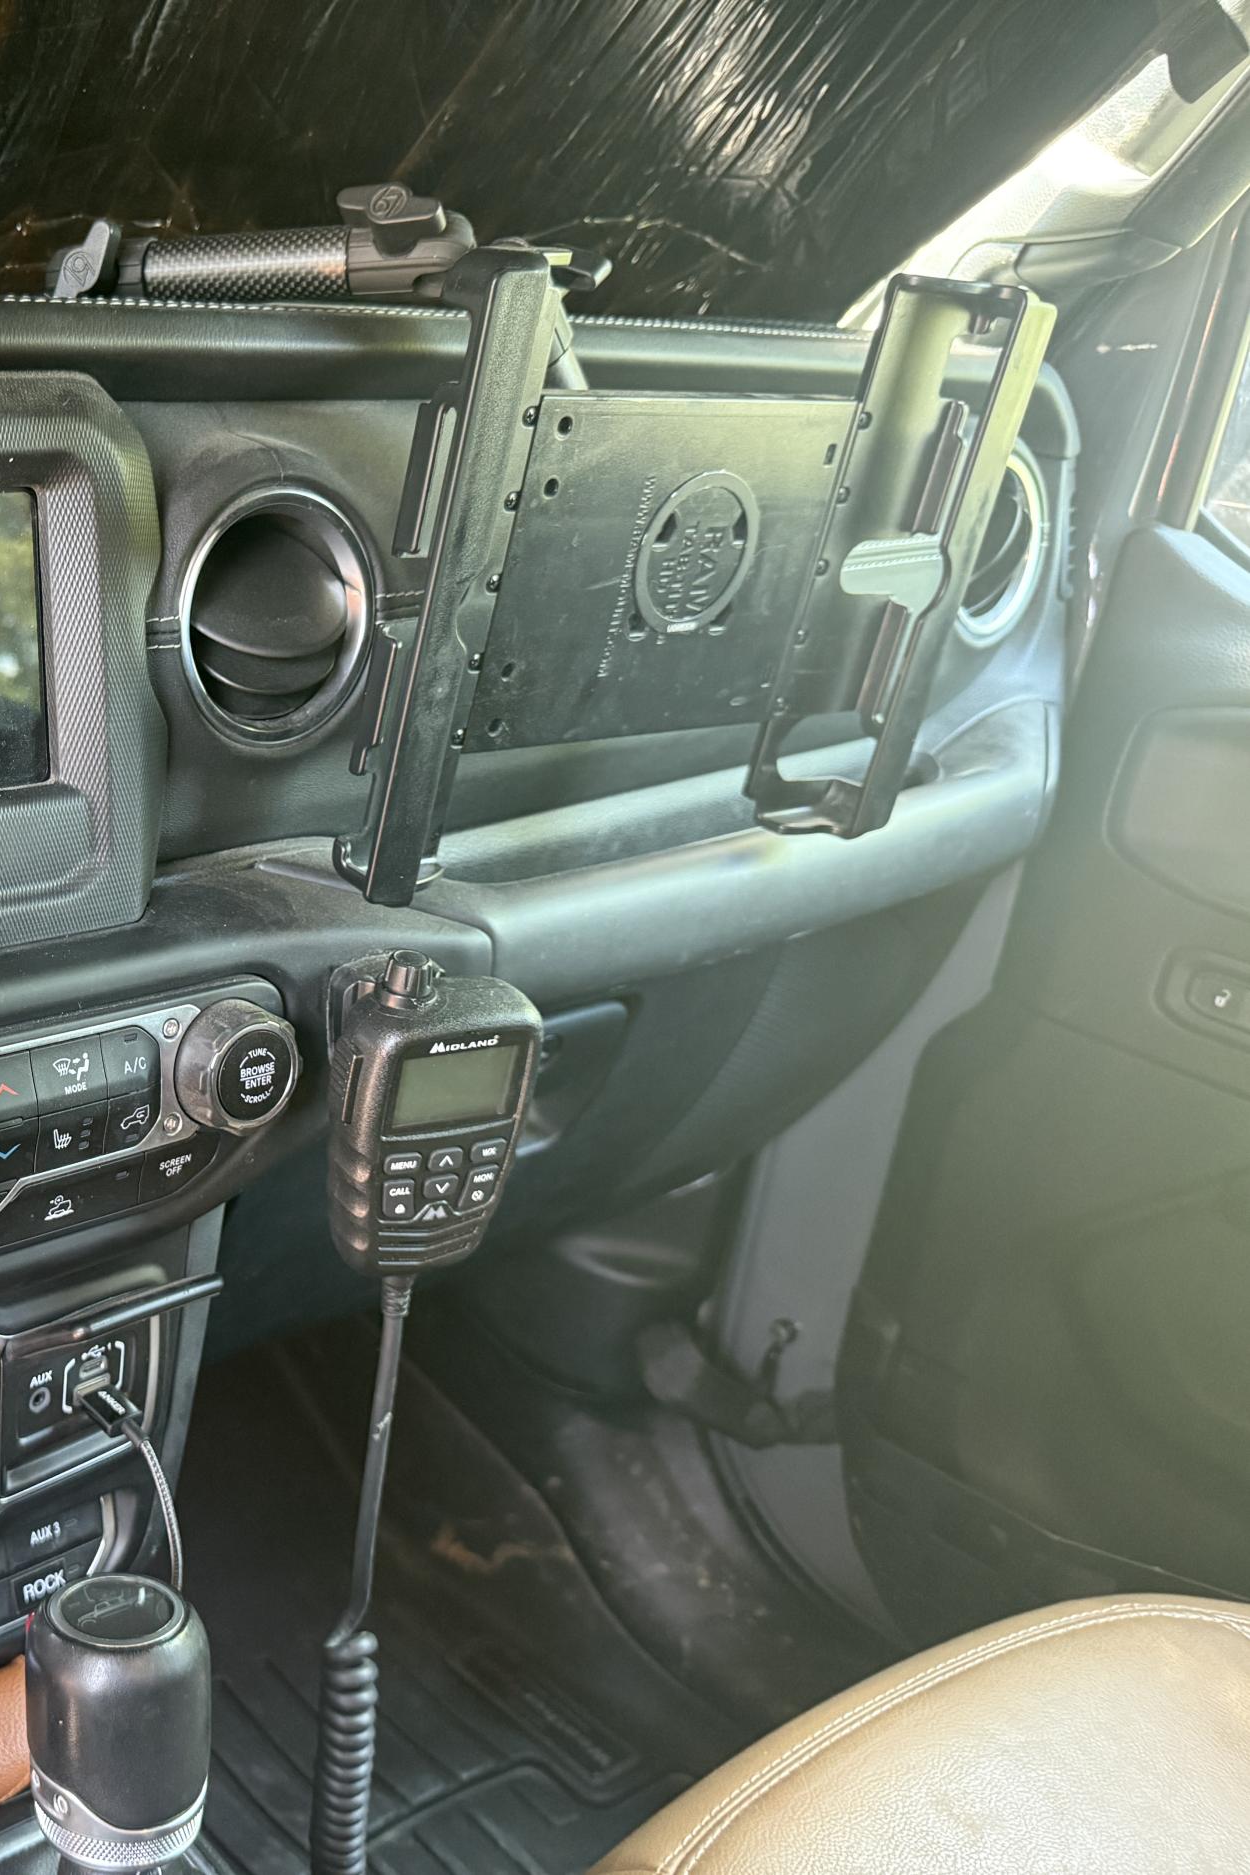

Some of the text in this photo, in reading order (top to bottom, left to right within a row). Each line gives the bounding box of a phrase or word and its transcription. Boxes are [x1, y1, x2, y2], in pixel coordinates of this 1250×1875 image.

[248, 1047, 268, 1059] TUNE
[429, 1038, 499, 1054] MIDLAND
[124, 1056, 147, 1075] A/C
[240, 1061, 275, 1078] BROWSE
[64, 1081, 88, 1095] MODE
[244, 1075, 272, 1090] ENTER
[244, 1090, 271, 1104] SCROLL
[482, 1146, 497, 1157] WX
[159, 1153, 192, 1170] SCREEN
[390, 1160, 418, 1171] MENU
[165, 1164, 183, 1177] OFF
[389, 1186, 411, 1197] CALL
[29, 1370, 53, 1389] AUX
[97, 1390, 126, 1415] ANKER
[30, 1521, 61, 1547] AUX 3
[22, 1568, 67, 1604] ROCK
